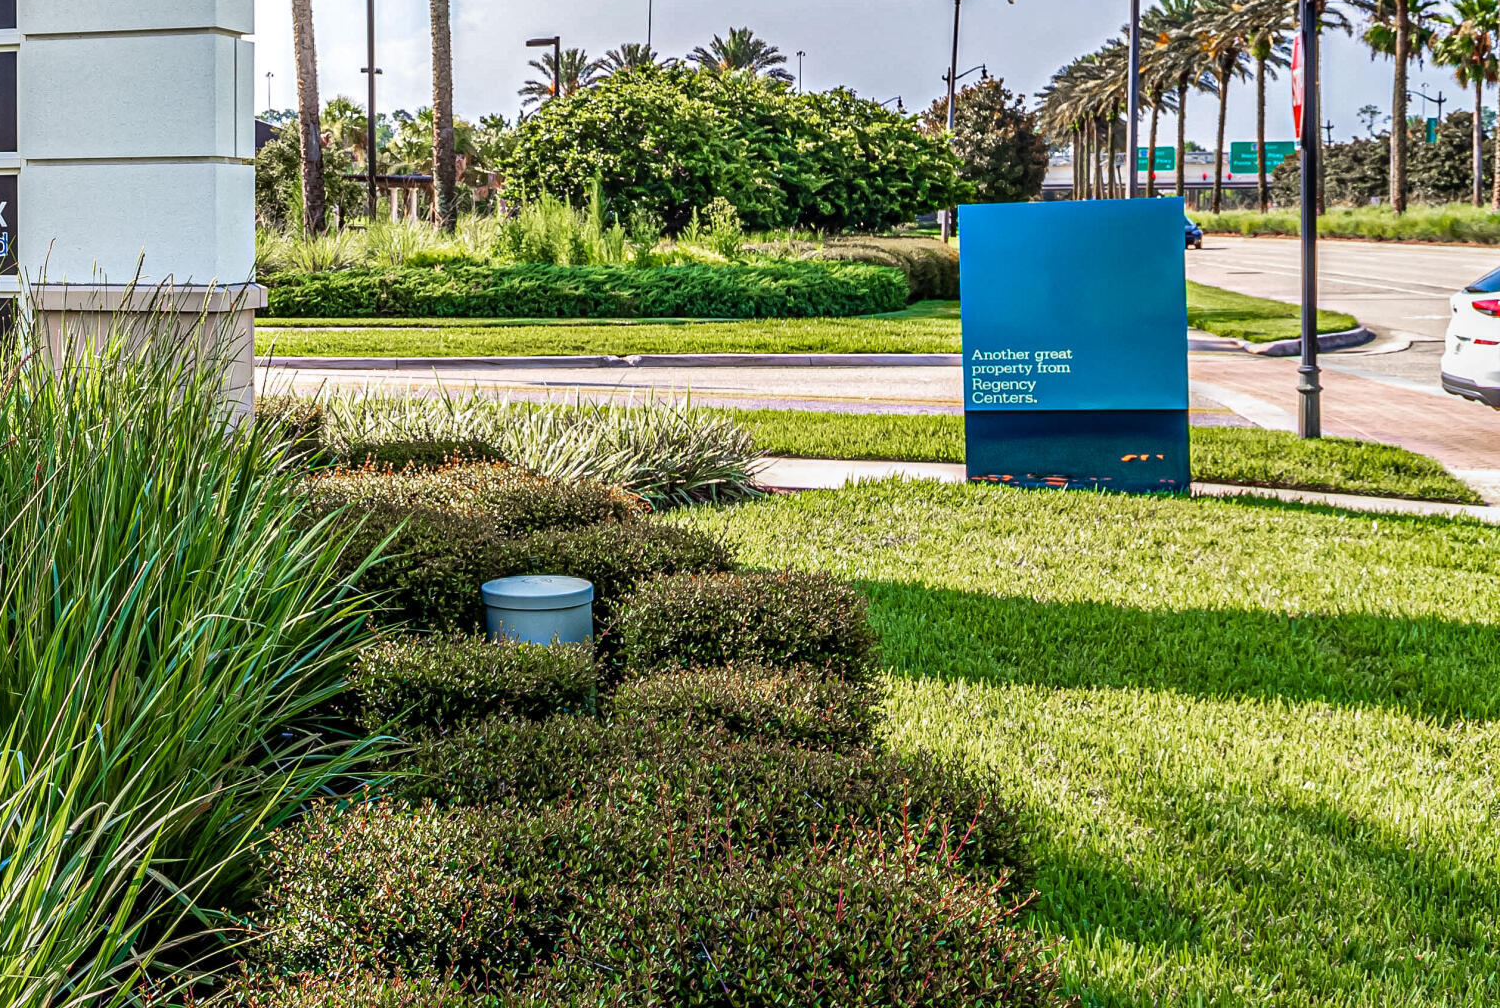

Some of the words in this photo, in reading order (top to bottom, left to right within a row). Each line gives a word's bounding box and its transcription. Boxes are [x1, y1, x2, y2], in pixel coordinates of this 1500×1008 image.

[971, 349, 1030, 360] Another
[1034, 349, 1073, 362] great
[971, 363, 1033, 376] property
[1037, 361, 1071, 373] from
[972, 378, 1037, 393] Regency
[972, 392, 1038, 404] Centers.
